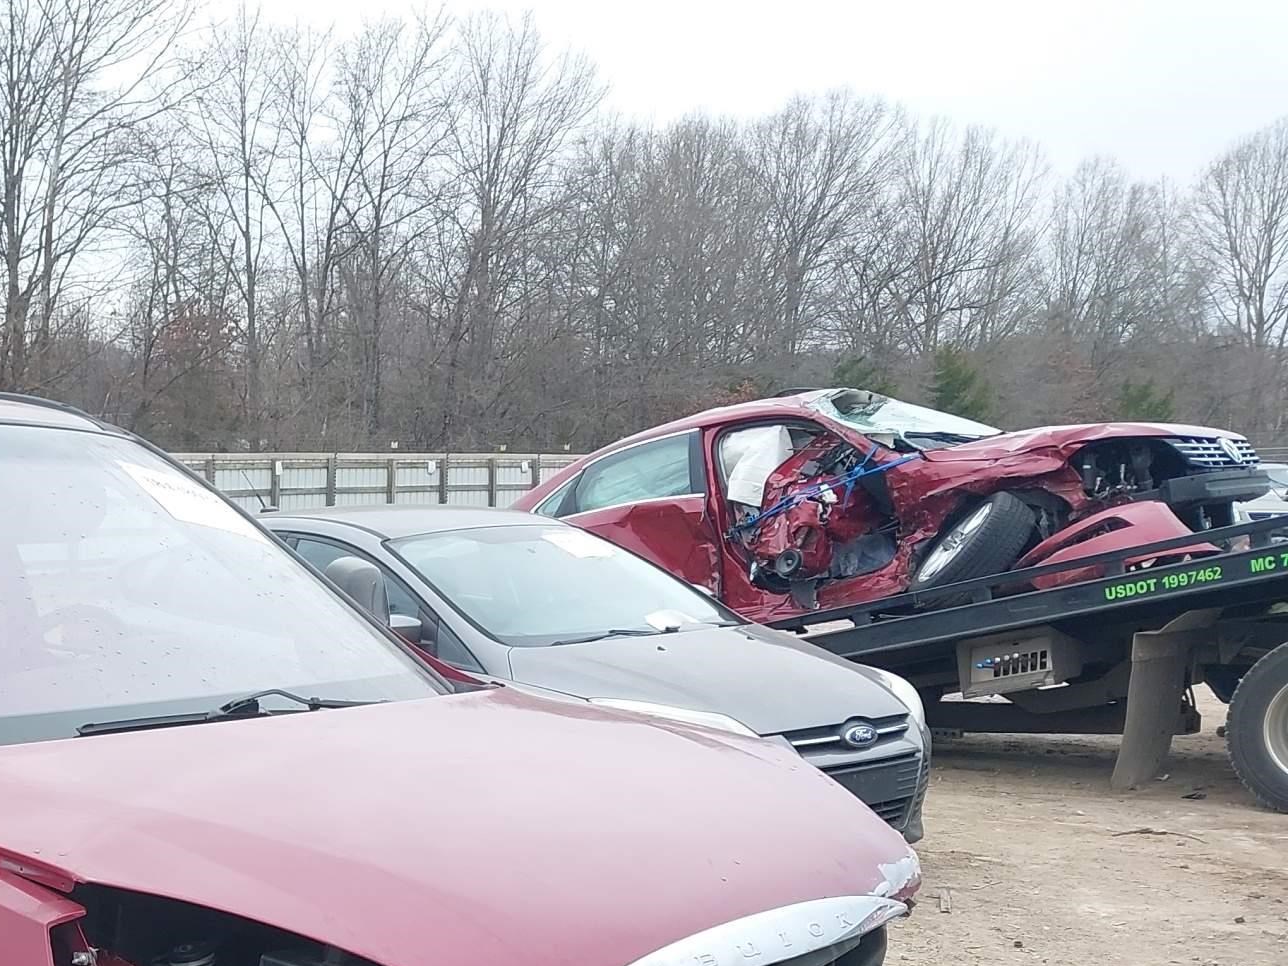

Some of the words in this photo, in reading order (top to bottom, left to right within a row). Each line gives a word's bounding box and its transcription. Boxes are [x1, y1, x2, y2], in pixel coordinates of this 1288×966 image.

[1105, 579, 1157, 600] USDOT
[1162, 567, 1222, 589] 1997462
[1250, 556, 1276, 572] MC
[855, 728, 872, 741] Ford
